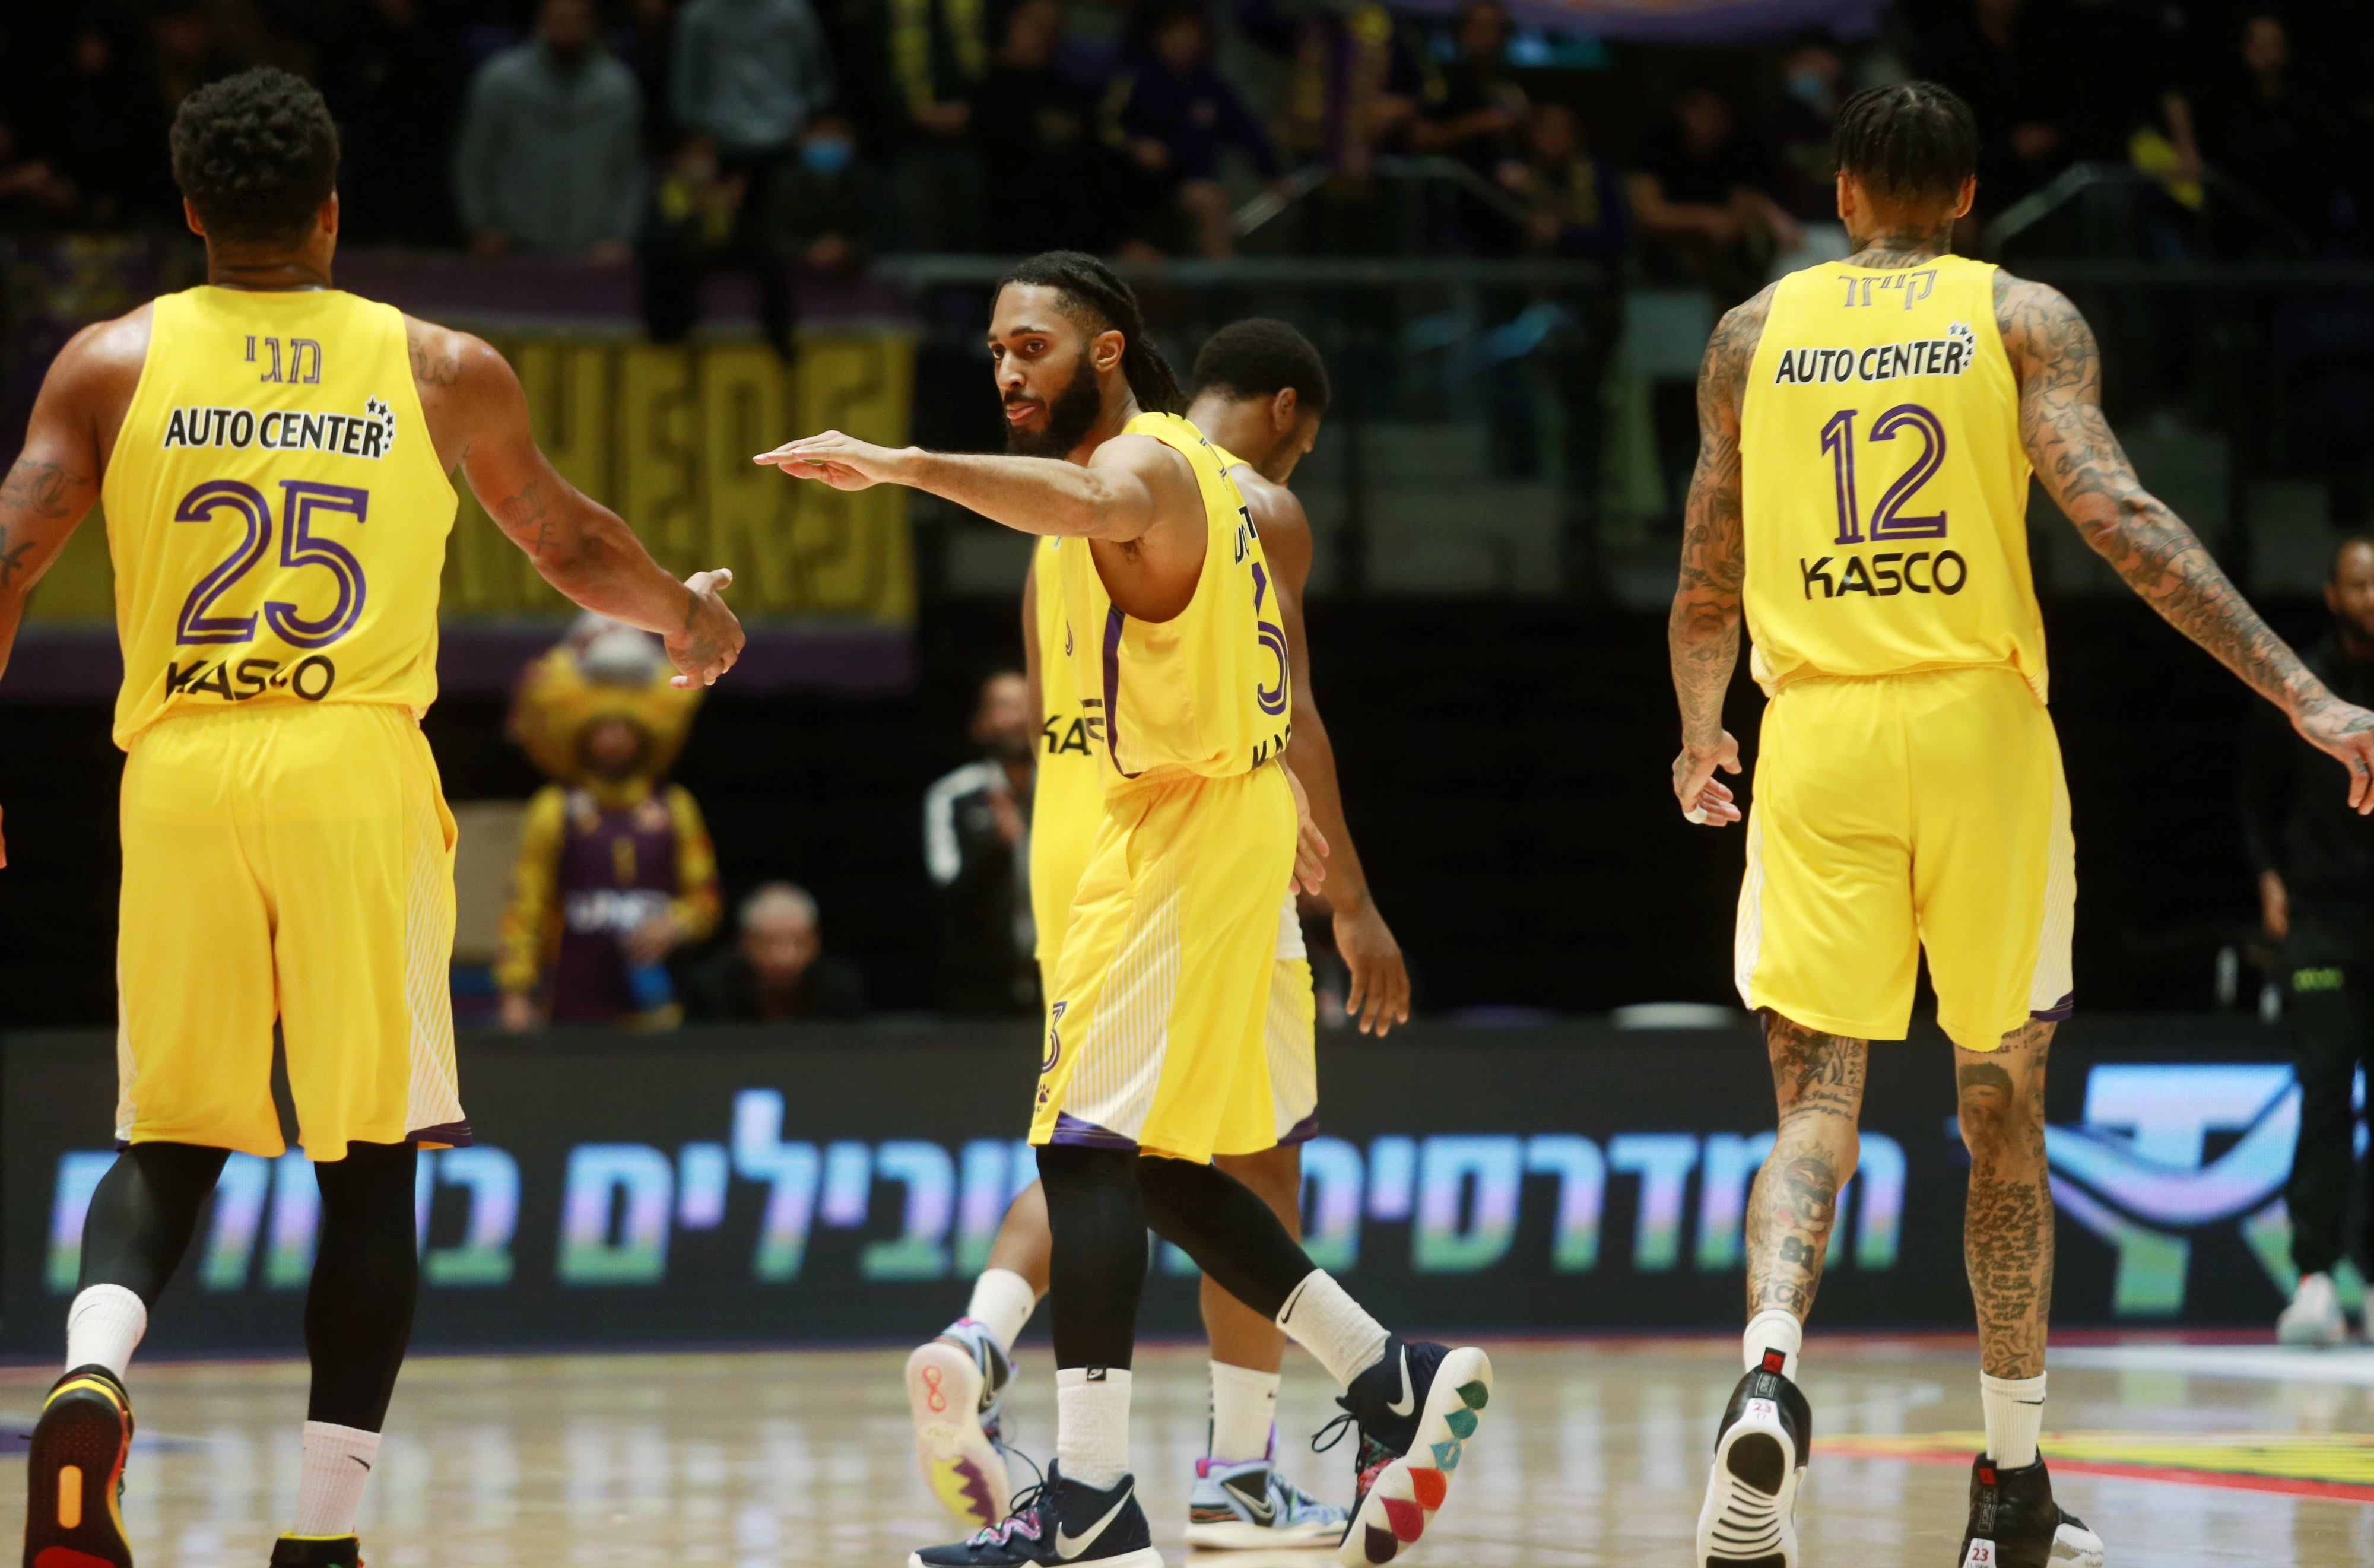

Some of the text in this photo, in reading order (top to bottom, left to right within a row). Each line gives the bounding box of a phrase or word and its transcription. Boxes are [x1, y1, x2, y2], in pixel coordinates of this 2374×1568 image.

[1837, 269, 1938, 310] קייזר
[244, 335, 323, 385] מגי
[1775, 339, 1963, 385] AUTO CENTER
[164, 408, 385, 458] AUTO CENTER
[1820, 403, 1947, 546] 12
[174, 479, 369, 649] 25
[1800, 550, 1967, 601] KASCO
[1972, 1547, 1989, 1561] 23
